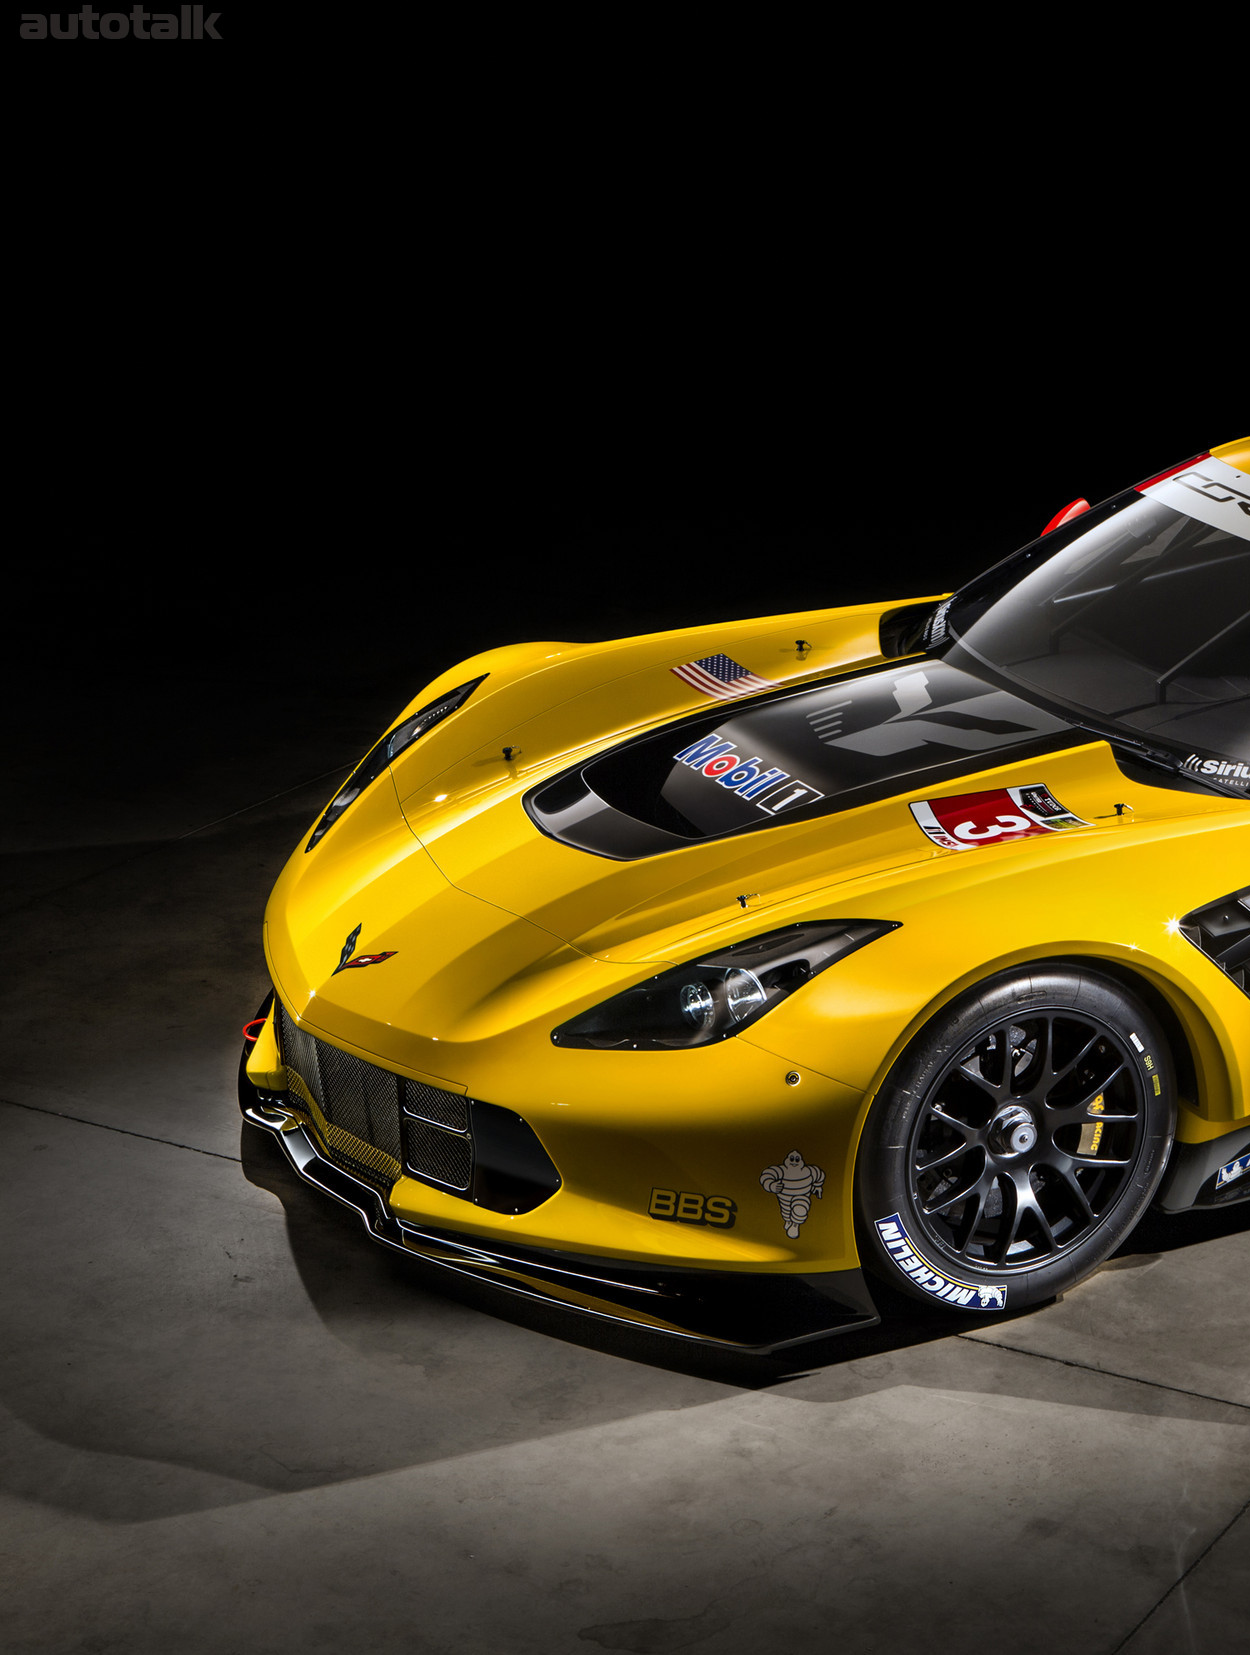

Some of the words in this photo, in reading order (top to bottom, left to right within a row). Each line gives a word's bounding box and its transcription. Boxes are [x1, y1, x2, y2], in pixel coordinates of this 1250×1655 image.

[673, 733, 791, 801] Mobil
[953, 815, 1032, 840] 3
[649, 1188, 738, 1229] BBS
[878, 1222, 977, 1306] MICHELIN
